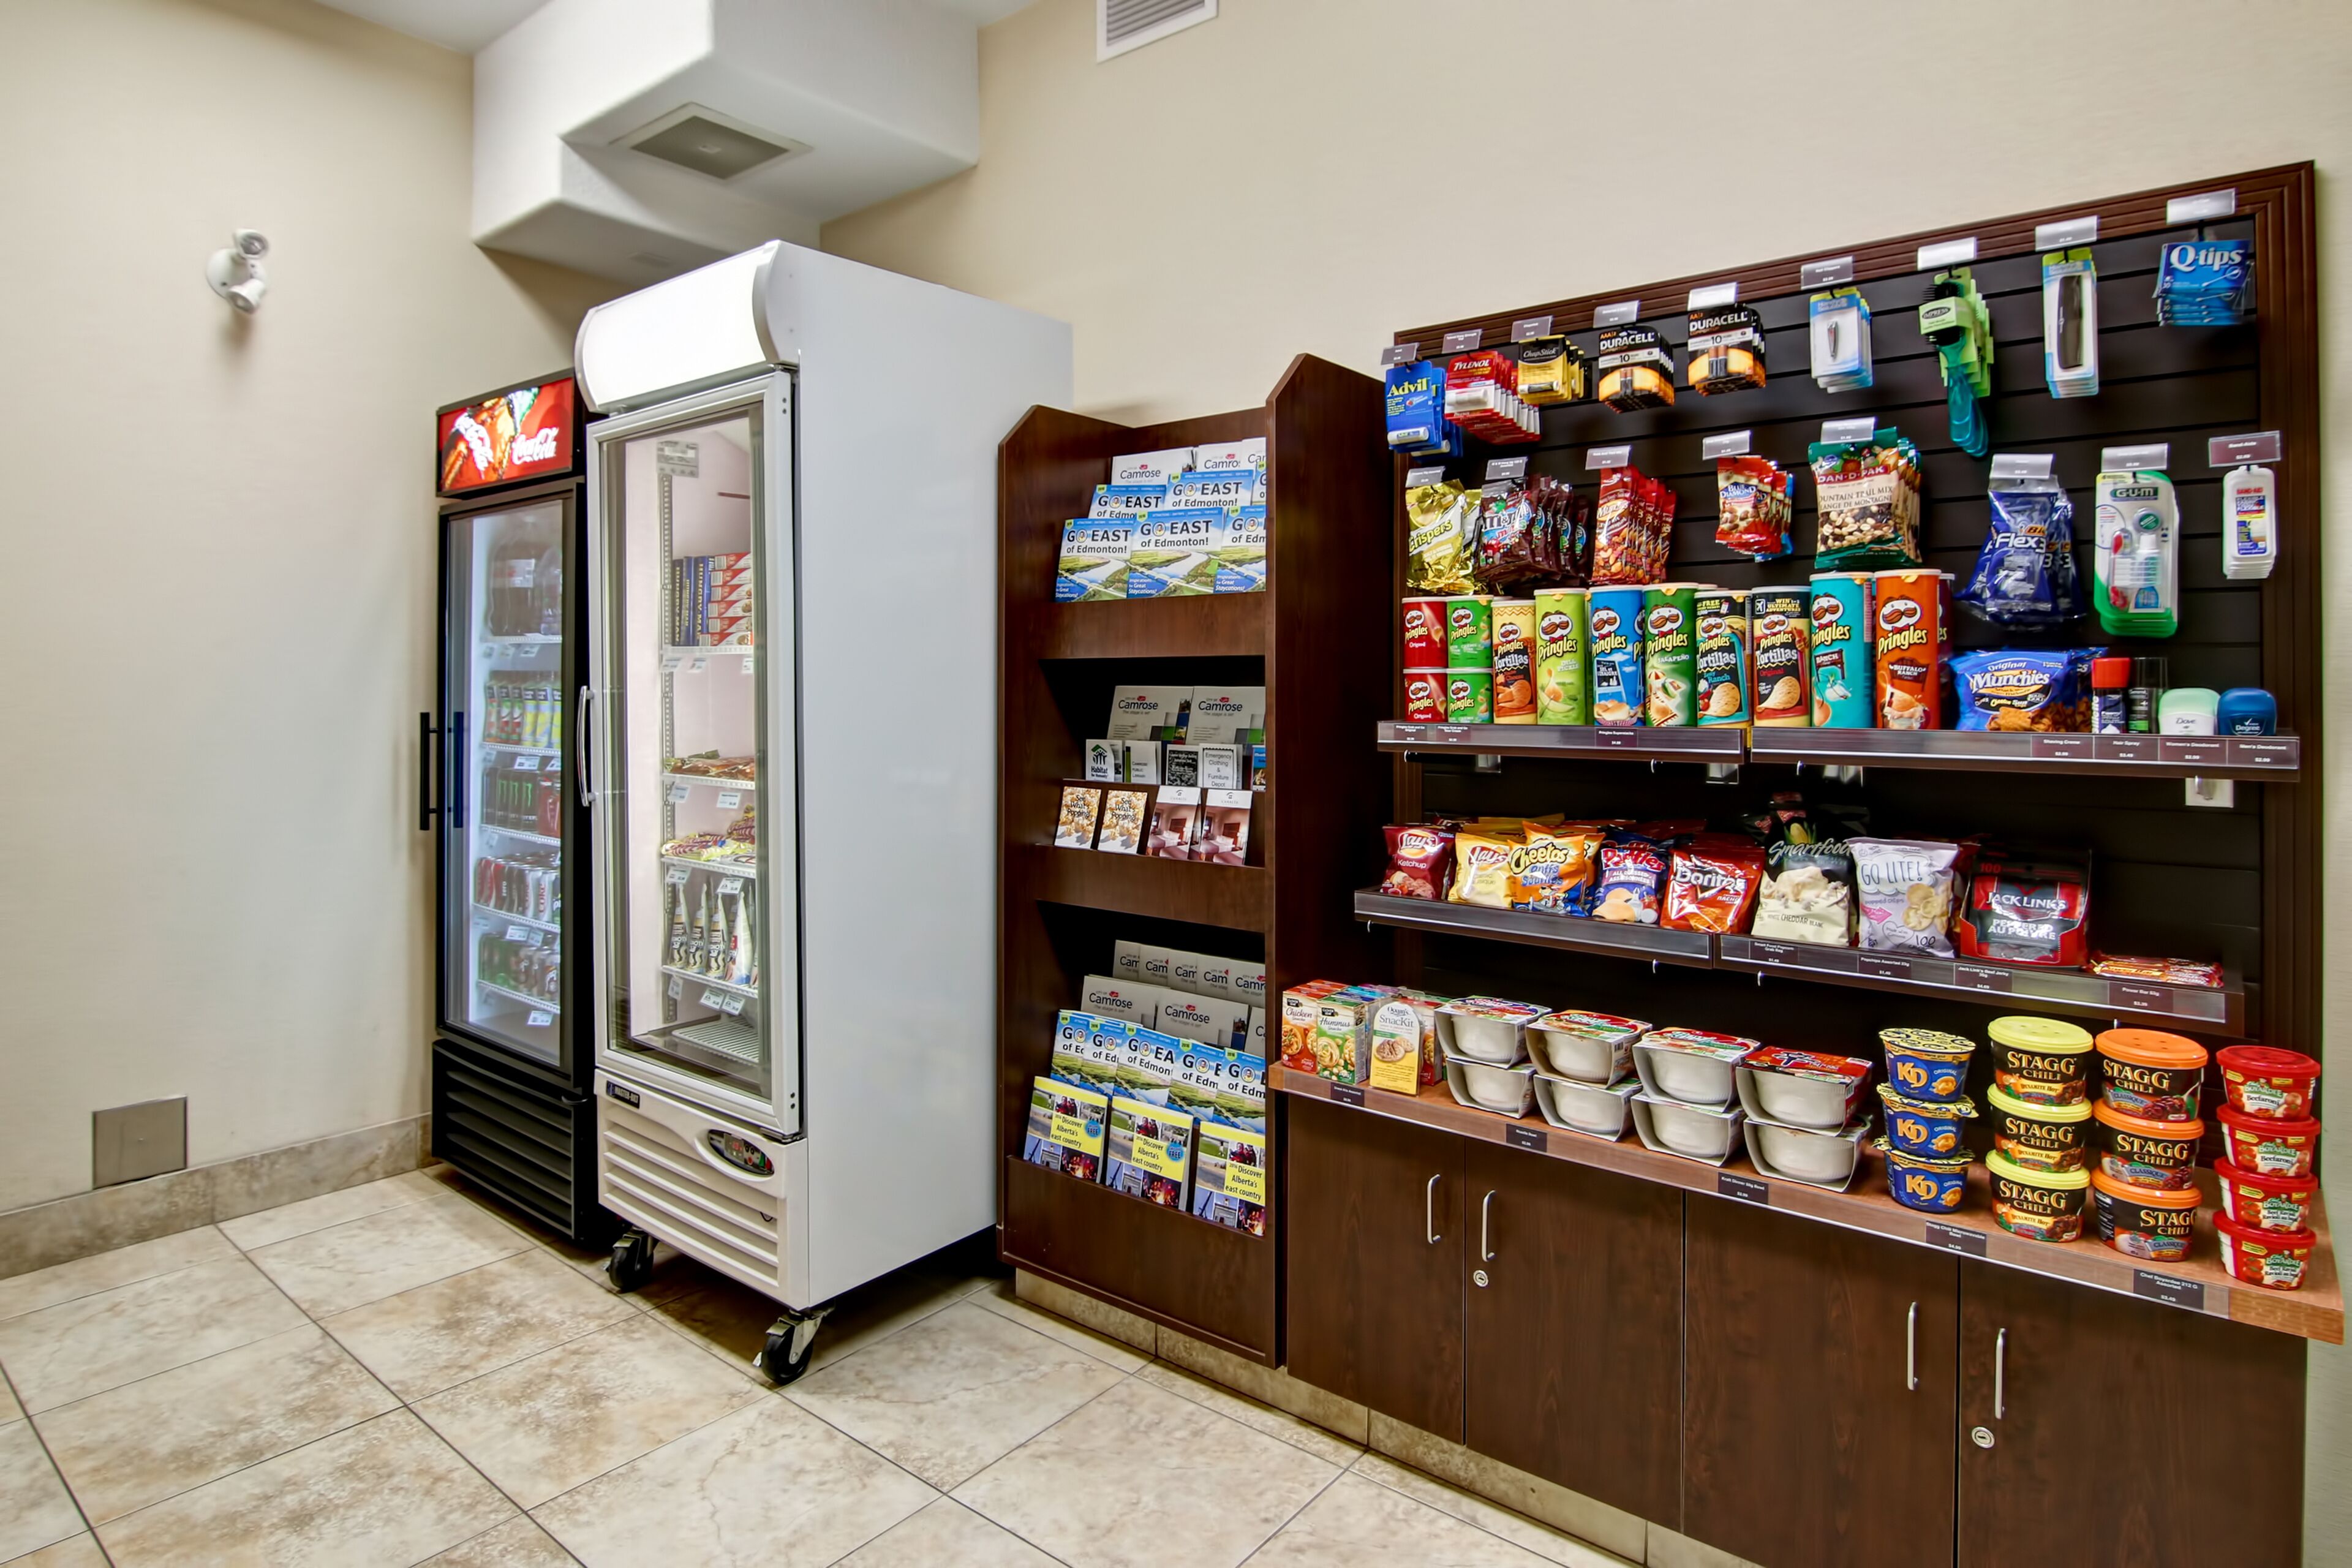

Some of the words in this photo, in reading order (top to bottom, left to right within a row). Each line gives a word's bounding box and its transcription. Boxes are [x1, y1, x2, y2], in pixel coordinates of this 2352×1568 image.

[2169, 246, 2243, 271] Q-tips
[1689, 312, 1747, 331] DURACELL
[1600, 333, 1654, 349] DURACELL
[1523, 348, 1558, 358] ChapStick
[1619, 354, 1629, 363] 10
[1453, 360, 1490, 371] TYLENOL
[1387, 378, 1428, 397] Advil
[1120, 469, 1161, 480] Camrose
[1201, 482, 1242, 495] EAST
[1720, 486, 1757, 498] DIAMOND
[1125, 496, 1161, 508] EAST
[1185, 499, 1237, 507] Edmonton!
[1170, 520, 1212, 534] EAST
[1091, 530, 1131, 541] EAST
[1155, 537, 1208, 547] Edmonton!
[1232, 535, 1242, 543] of
[1405, 626, 1428, 644] Pringles
[1451, 625, 1477, 644] Pringles
[1760, 631, 1792, 651] Pringles
[1879, 625, 1927, 657] Pringles
[1498, 639, 1524, 657] Pringles
[1538, 637, 1578, 663] Pringles
[1647, 631, 1688, 662] Pringles
[1699, 635, 1730, 655] Pringles
[1494, 654, 1529, 669] Tortillas
[1697, 652, 1736, 669] Tortillas
[1756, 648, 1798, 666] Tortillas
[1988, 662, 2027, 671] Original
[1708, 673, 1730, 684] Ranch
[1972, 671, 2050, 693] Munchies
[1118, 700, 1158, 710] Camrose
[1198, 701, 1243, 712] Camrose
[1409, 698, 1433, 715] Pringles
[1450, 697, 1474, 716] Pringles
[1769, 839, 1851, 865] Smartfood
[1397, 859, 1426, 869] Ketchup
[1510, 843, 1569, 875] Cheetos
[1676, 866, 1746, 889] Doritos
[1861, 864, 1880, 885] GO
[1887, 861, 1922, 883] LITE!
[1986, 892, 2021, 907] JACK
[1781, 914, 1808, 924] CHEDDAR
[1988, 925, 2006, 934] AU
[1916, 935, 1936, 945] 100
[1089, 992, 1133, 1009] Camrose
[1165, 1005, 1210, 1024] Camrose
[1286, 1008, 1312, 1018] Chicken
[1320, 1017, 1350, 1027] Hummus
[1380, 1015, 1414, 1028] SnacKit
[1128, 1056, 1137, 1065] of
[2007, 1051, 2075, 1075] STAGG
[1182, 1072, 1193, 1082] of
[1897, 1061, 1928, 1087] KD
[2022, 1069, 2061, 1080] CHILI
[2103, 1059, 2169, 1090] STAGG
[1228, 1082, 1238, 1091] of
[2115, 1079, 2154, 1094] CHILI
[2247, 1095, 2280, 1105] Beefaroni
[1061, 1117, 1082, 1128] Discover
[1057, 1125, 1078, 1136] Alberta's
[1087, 1127, 1098, 1136] FREE
[1897, 1118, 1928, 1144] KD
[2006, 1117, 2073, 1142] STAGG
[1063, 1136, 1082, 1148] country
[1143, 1139, 1163, 1151] Discover
[2021, 1136, 2059, 1148] CHILI
[2117, 1134, 2188, 1159] STAGG
[1138, 1147, 1159, 1160] Alberta's
[1169, 1150, 1181, 1159] FREE
[2133, 1153, 2174, 1166] CHILI
[1144, 1159, 1163, 1172] country
[1238, 1165, 1262, 1179] Discover
[1231, 1175, 1257, 1188] Alberta's
[1905, 1175, 1938, 1200] KD
[1239, 1187, 1262, 1201] country
[2000, 1180, 2066, 1208] STAGG
[2013, 1200, 2052, 1214] CHILI
[2157, 1226, 2188, 1235] CHILI
